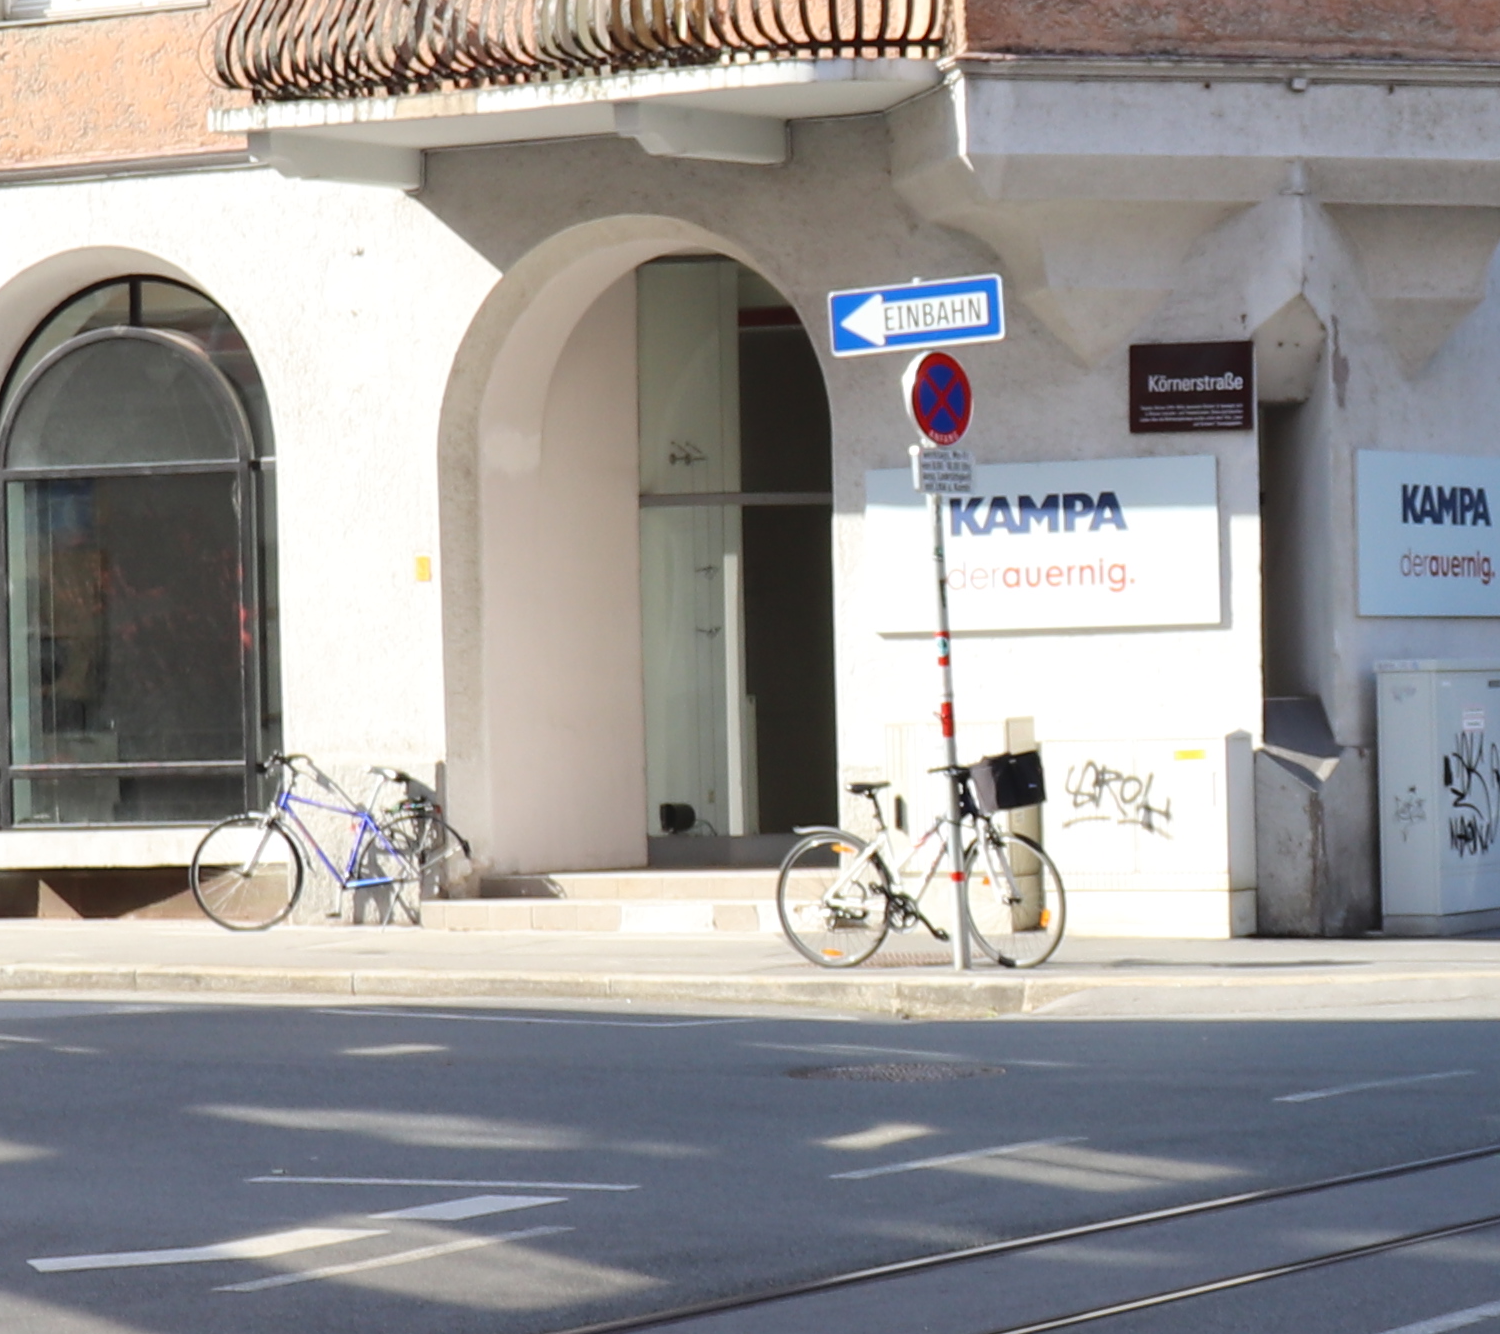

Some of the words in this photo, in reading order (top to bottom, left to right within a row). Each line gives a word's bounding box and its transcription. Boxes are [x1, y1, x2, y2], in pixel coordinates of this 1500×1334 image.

[884, 297, 982, 331] EINBAHN
[1148, 372, 1244, 393] Körnerstraße
[950, 491, 1129, 536] KAMPA
[1402, 484, 1492, 526] KAMPA
